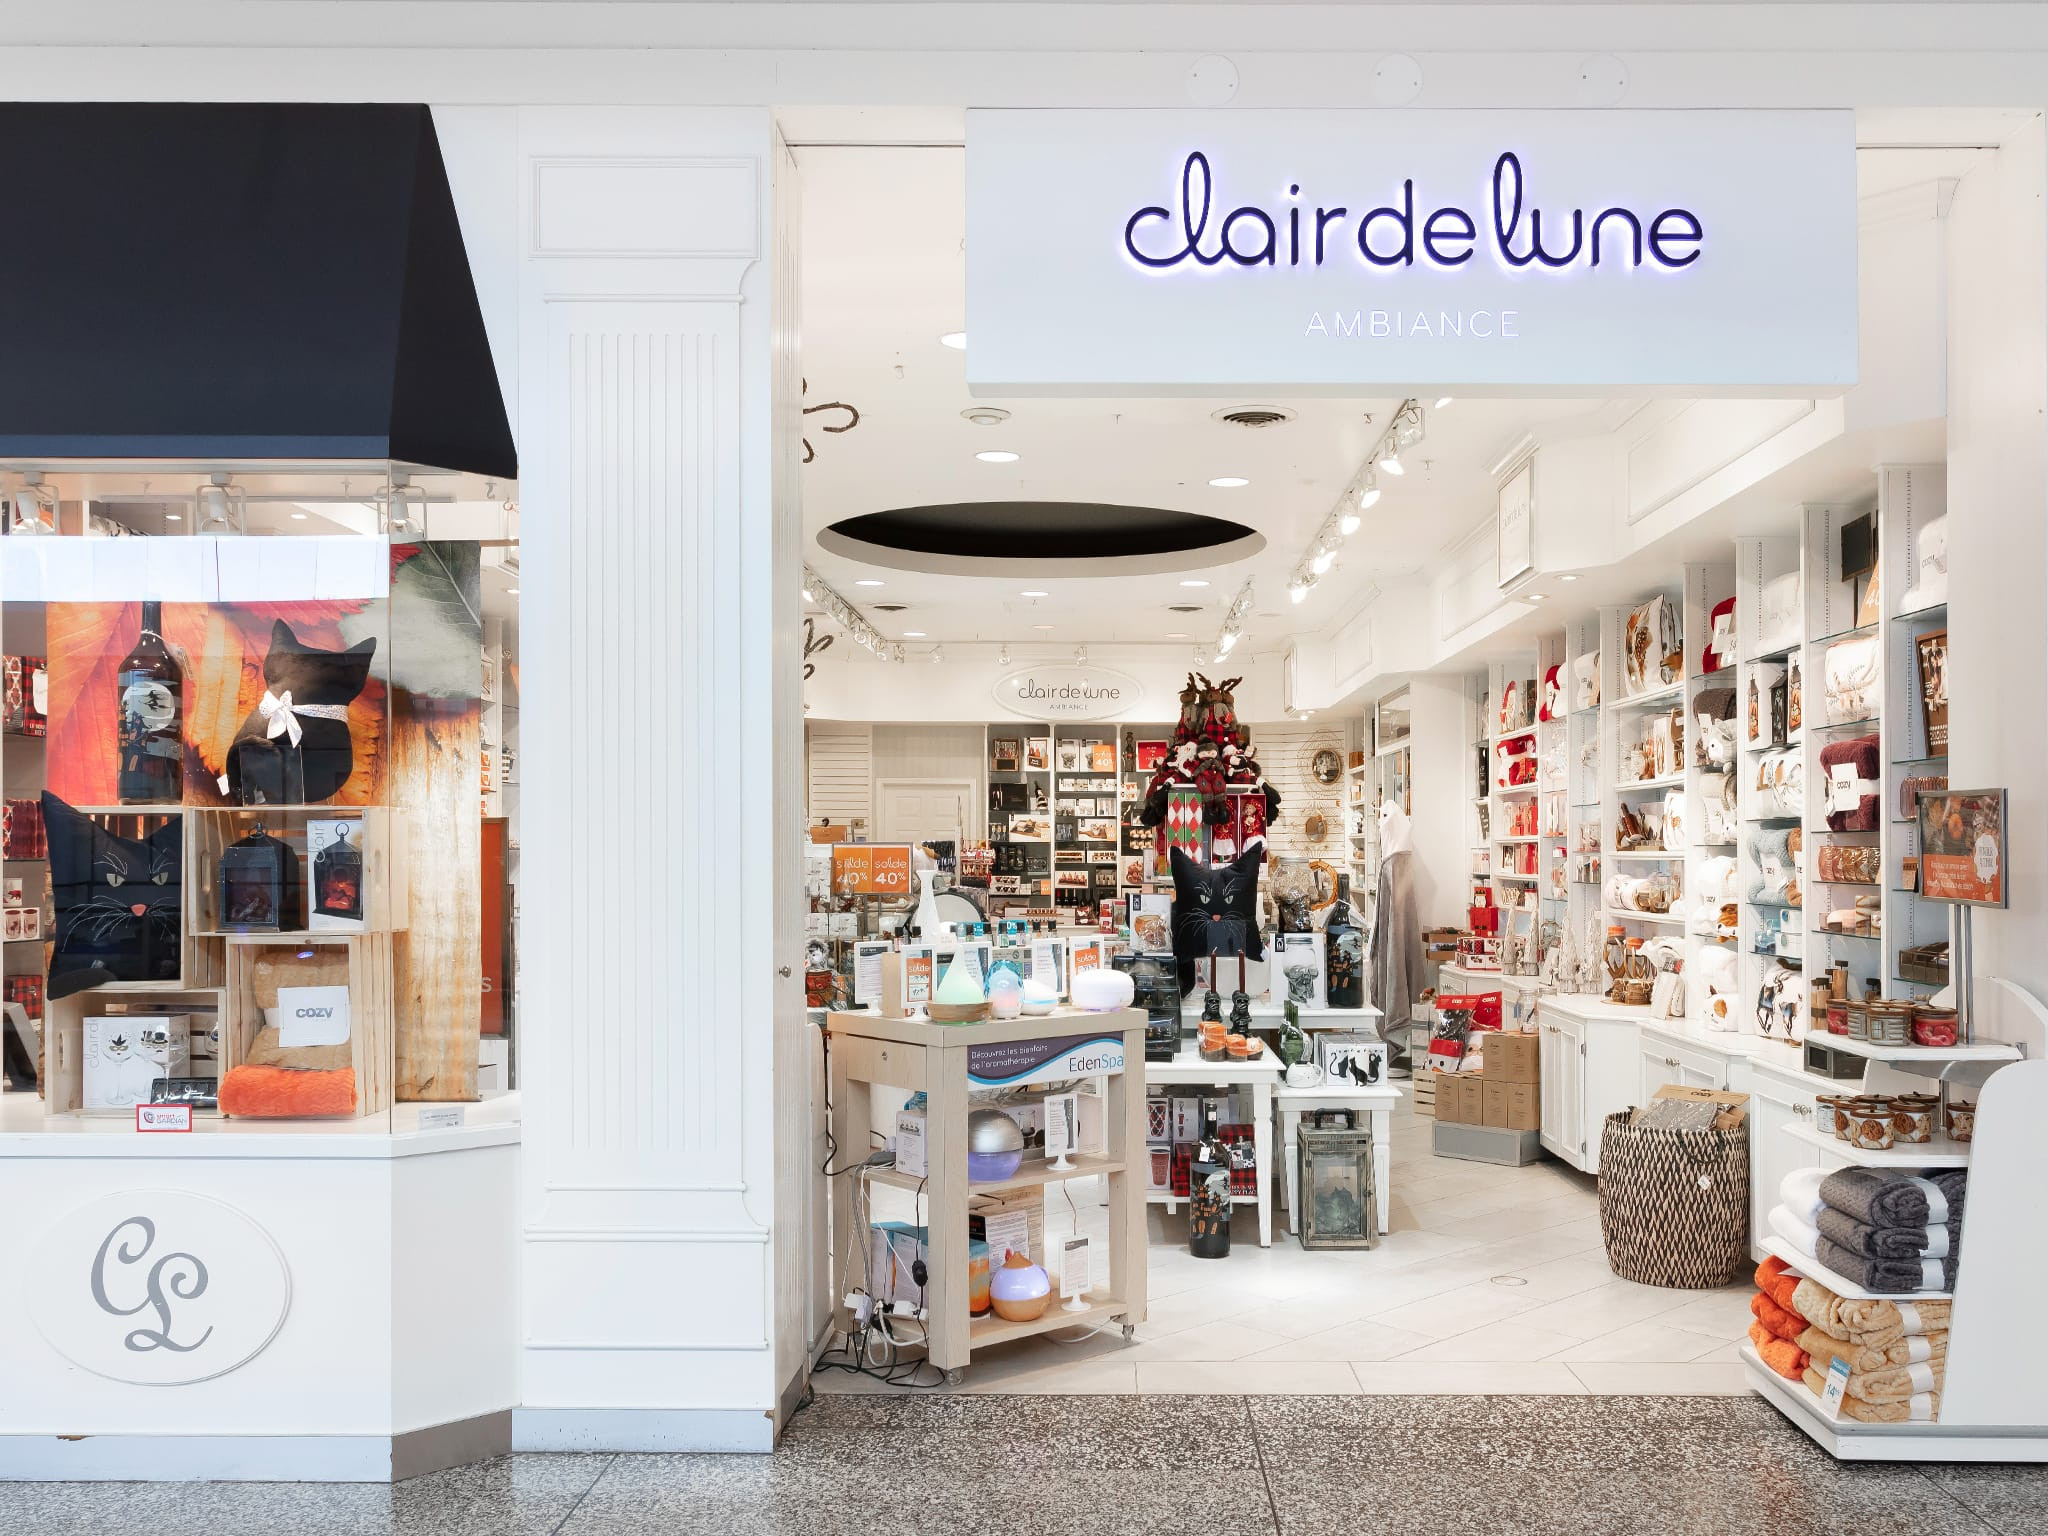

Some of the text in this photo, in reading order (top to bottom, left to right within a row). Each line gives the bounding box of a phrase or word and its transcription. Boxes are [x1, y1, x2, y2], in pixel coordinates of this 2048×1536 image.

[1304, 310, 1520, 337] AMBIANCE
[875, 857, 907, 869] solde
[874, 871, 907, 885] 40%
[971, 1044, 1048, 1061] Découvrez les bienfaits
[971, 1062, 981, 1070] de
[1069, 1053, 1124, 1072] EdenSpa
